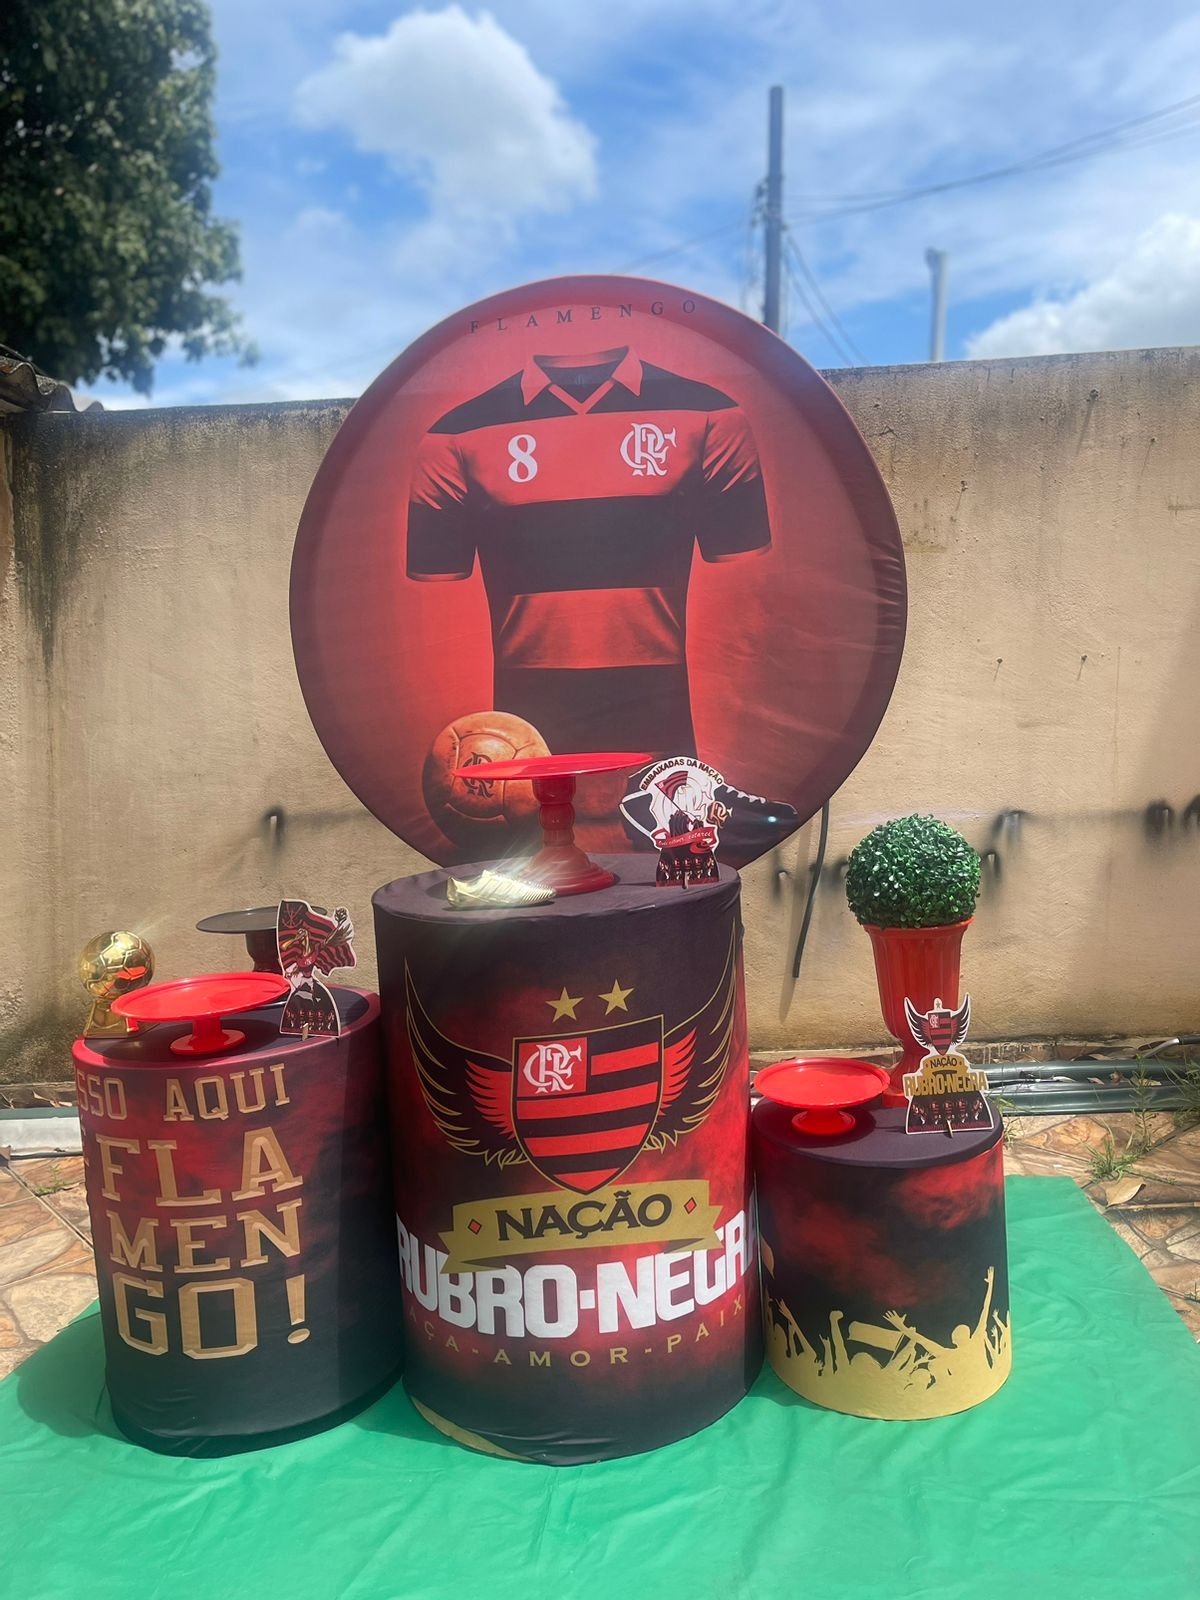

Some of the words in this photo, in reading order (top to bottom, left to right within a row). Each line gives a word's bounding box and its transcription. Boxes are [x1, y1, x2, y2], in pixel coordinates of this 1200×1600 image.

[468, 299, 696, 335] FLAMENGO
[506, 433, 539, 484] 8
[640, 758, 685, 791] EMBAIXADAS
[686, 759, 698, 768] DA
[698, 762, 723, 785] NAÇÃO
[903, 1072, 987, 1097] RUBRO-NEGRA
[929, 1055, 958, 1069] NAÇÃO
[163, 1062, 291, 1122] AQUI
[95, 1125, 304, 1208] FLA
[105, 1197, 303, 1274] MEN
[494, 1189, 673, 1240] NAÇÃO
[112, 1272, 311, 1361] GO!
